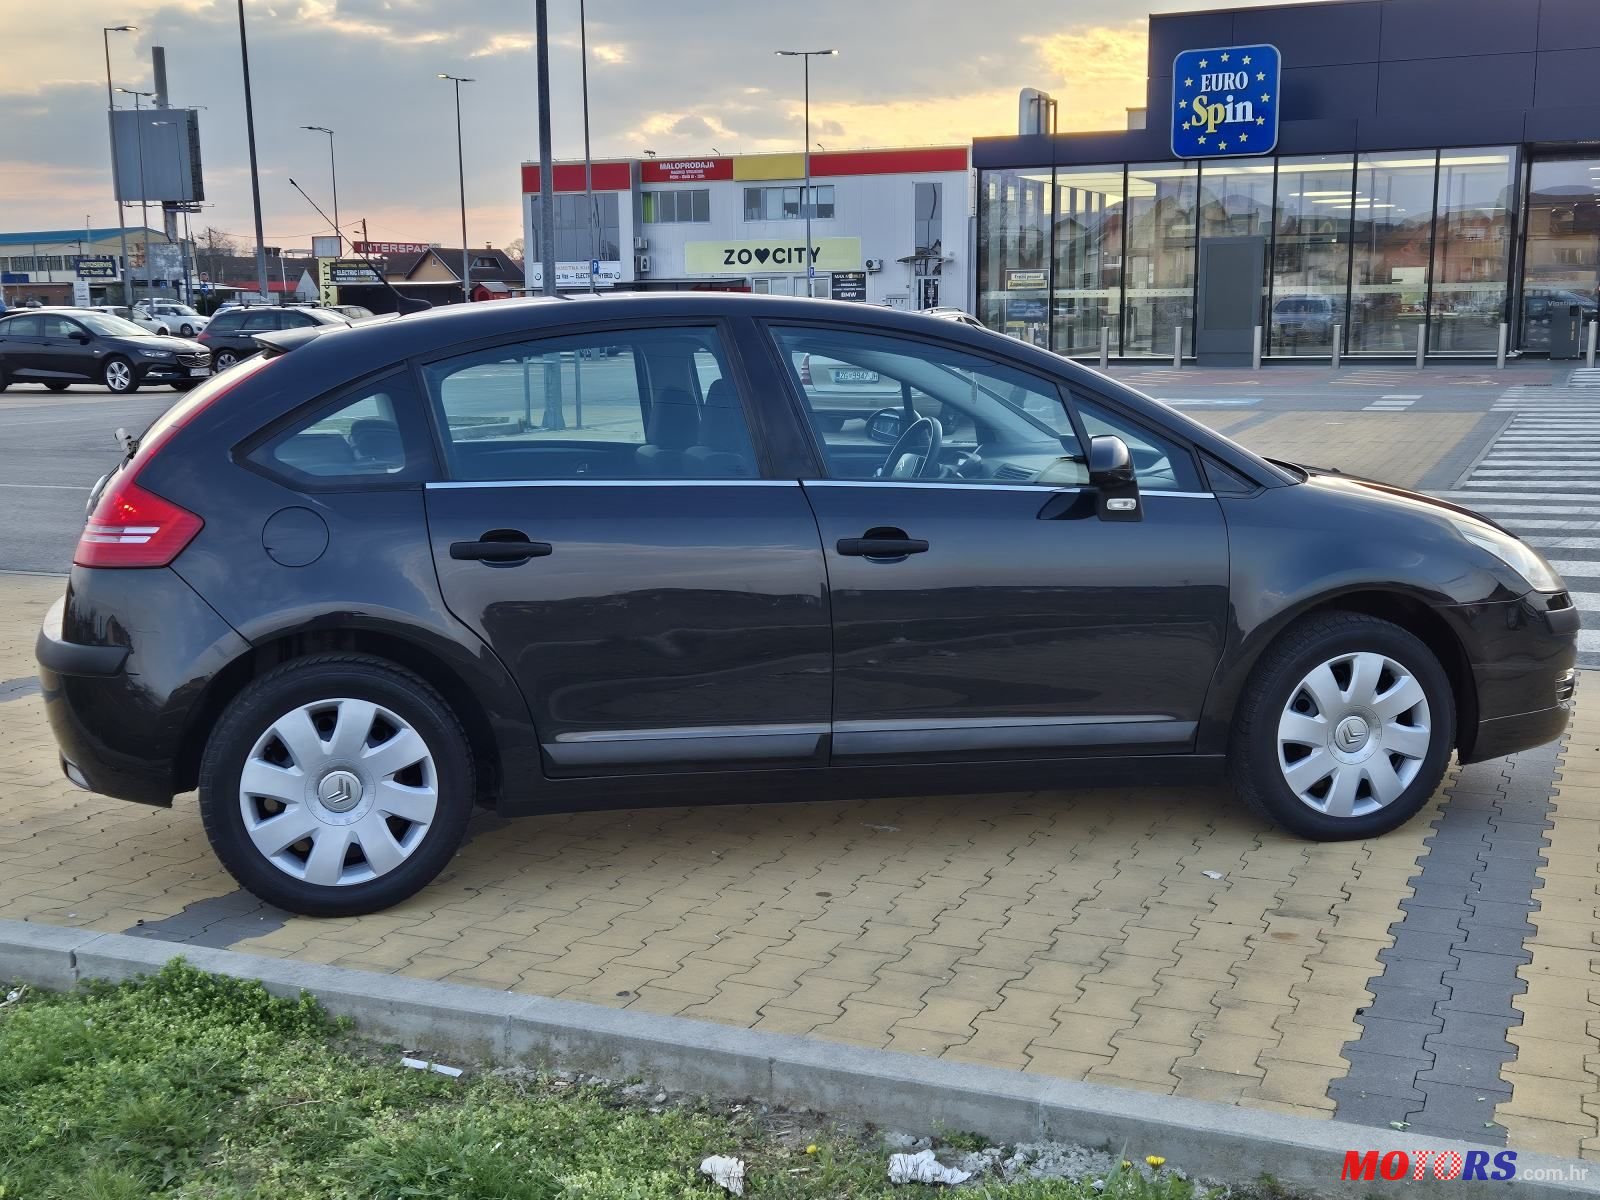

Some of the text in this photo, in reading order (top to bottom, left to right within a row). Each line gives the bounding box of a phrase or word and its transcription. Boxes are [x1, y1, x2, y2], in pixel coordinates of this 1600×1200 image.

[1200, 71, 1248, 92] EURO
[1191, 94, 1254, 133] Spin
[659, 161, 714, 170] MALOPRODAJA
[360, 243, 430, 253] INTERSPAR
